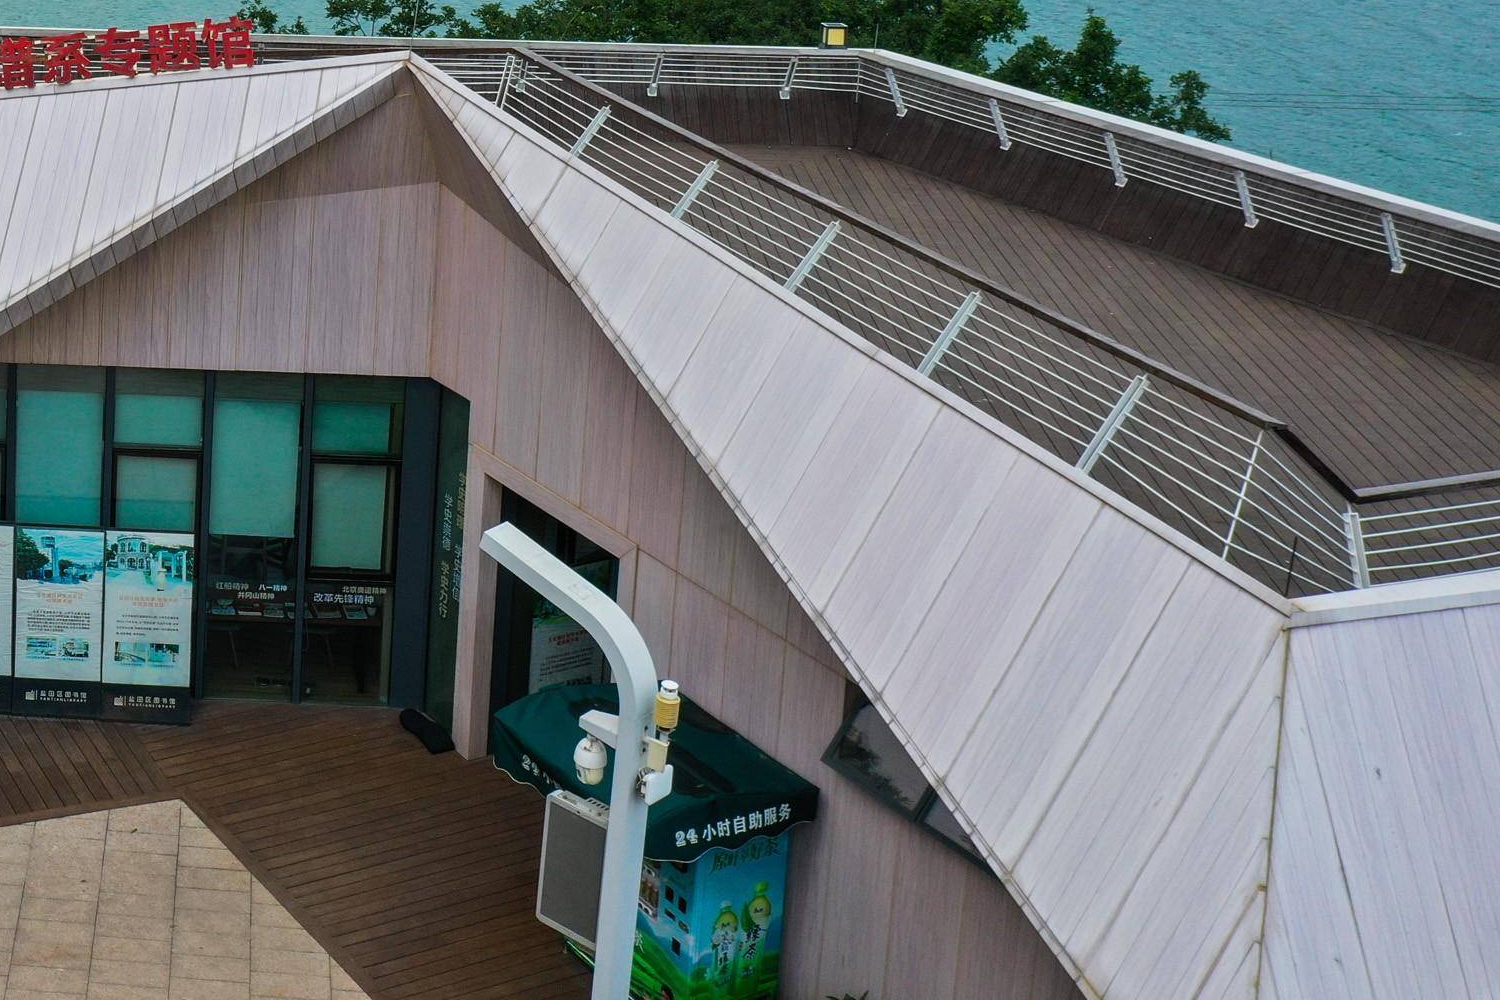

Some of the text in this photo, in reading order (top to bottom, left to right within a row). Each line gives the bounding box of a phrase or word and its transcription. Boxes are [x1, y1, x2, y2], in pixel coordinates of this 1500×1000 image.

[258, 583, 288, 592] 八一精神
[237, 591, 275, 600] 井冈山精神
[313, 592, 375, 605] 改革先锋精神
